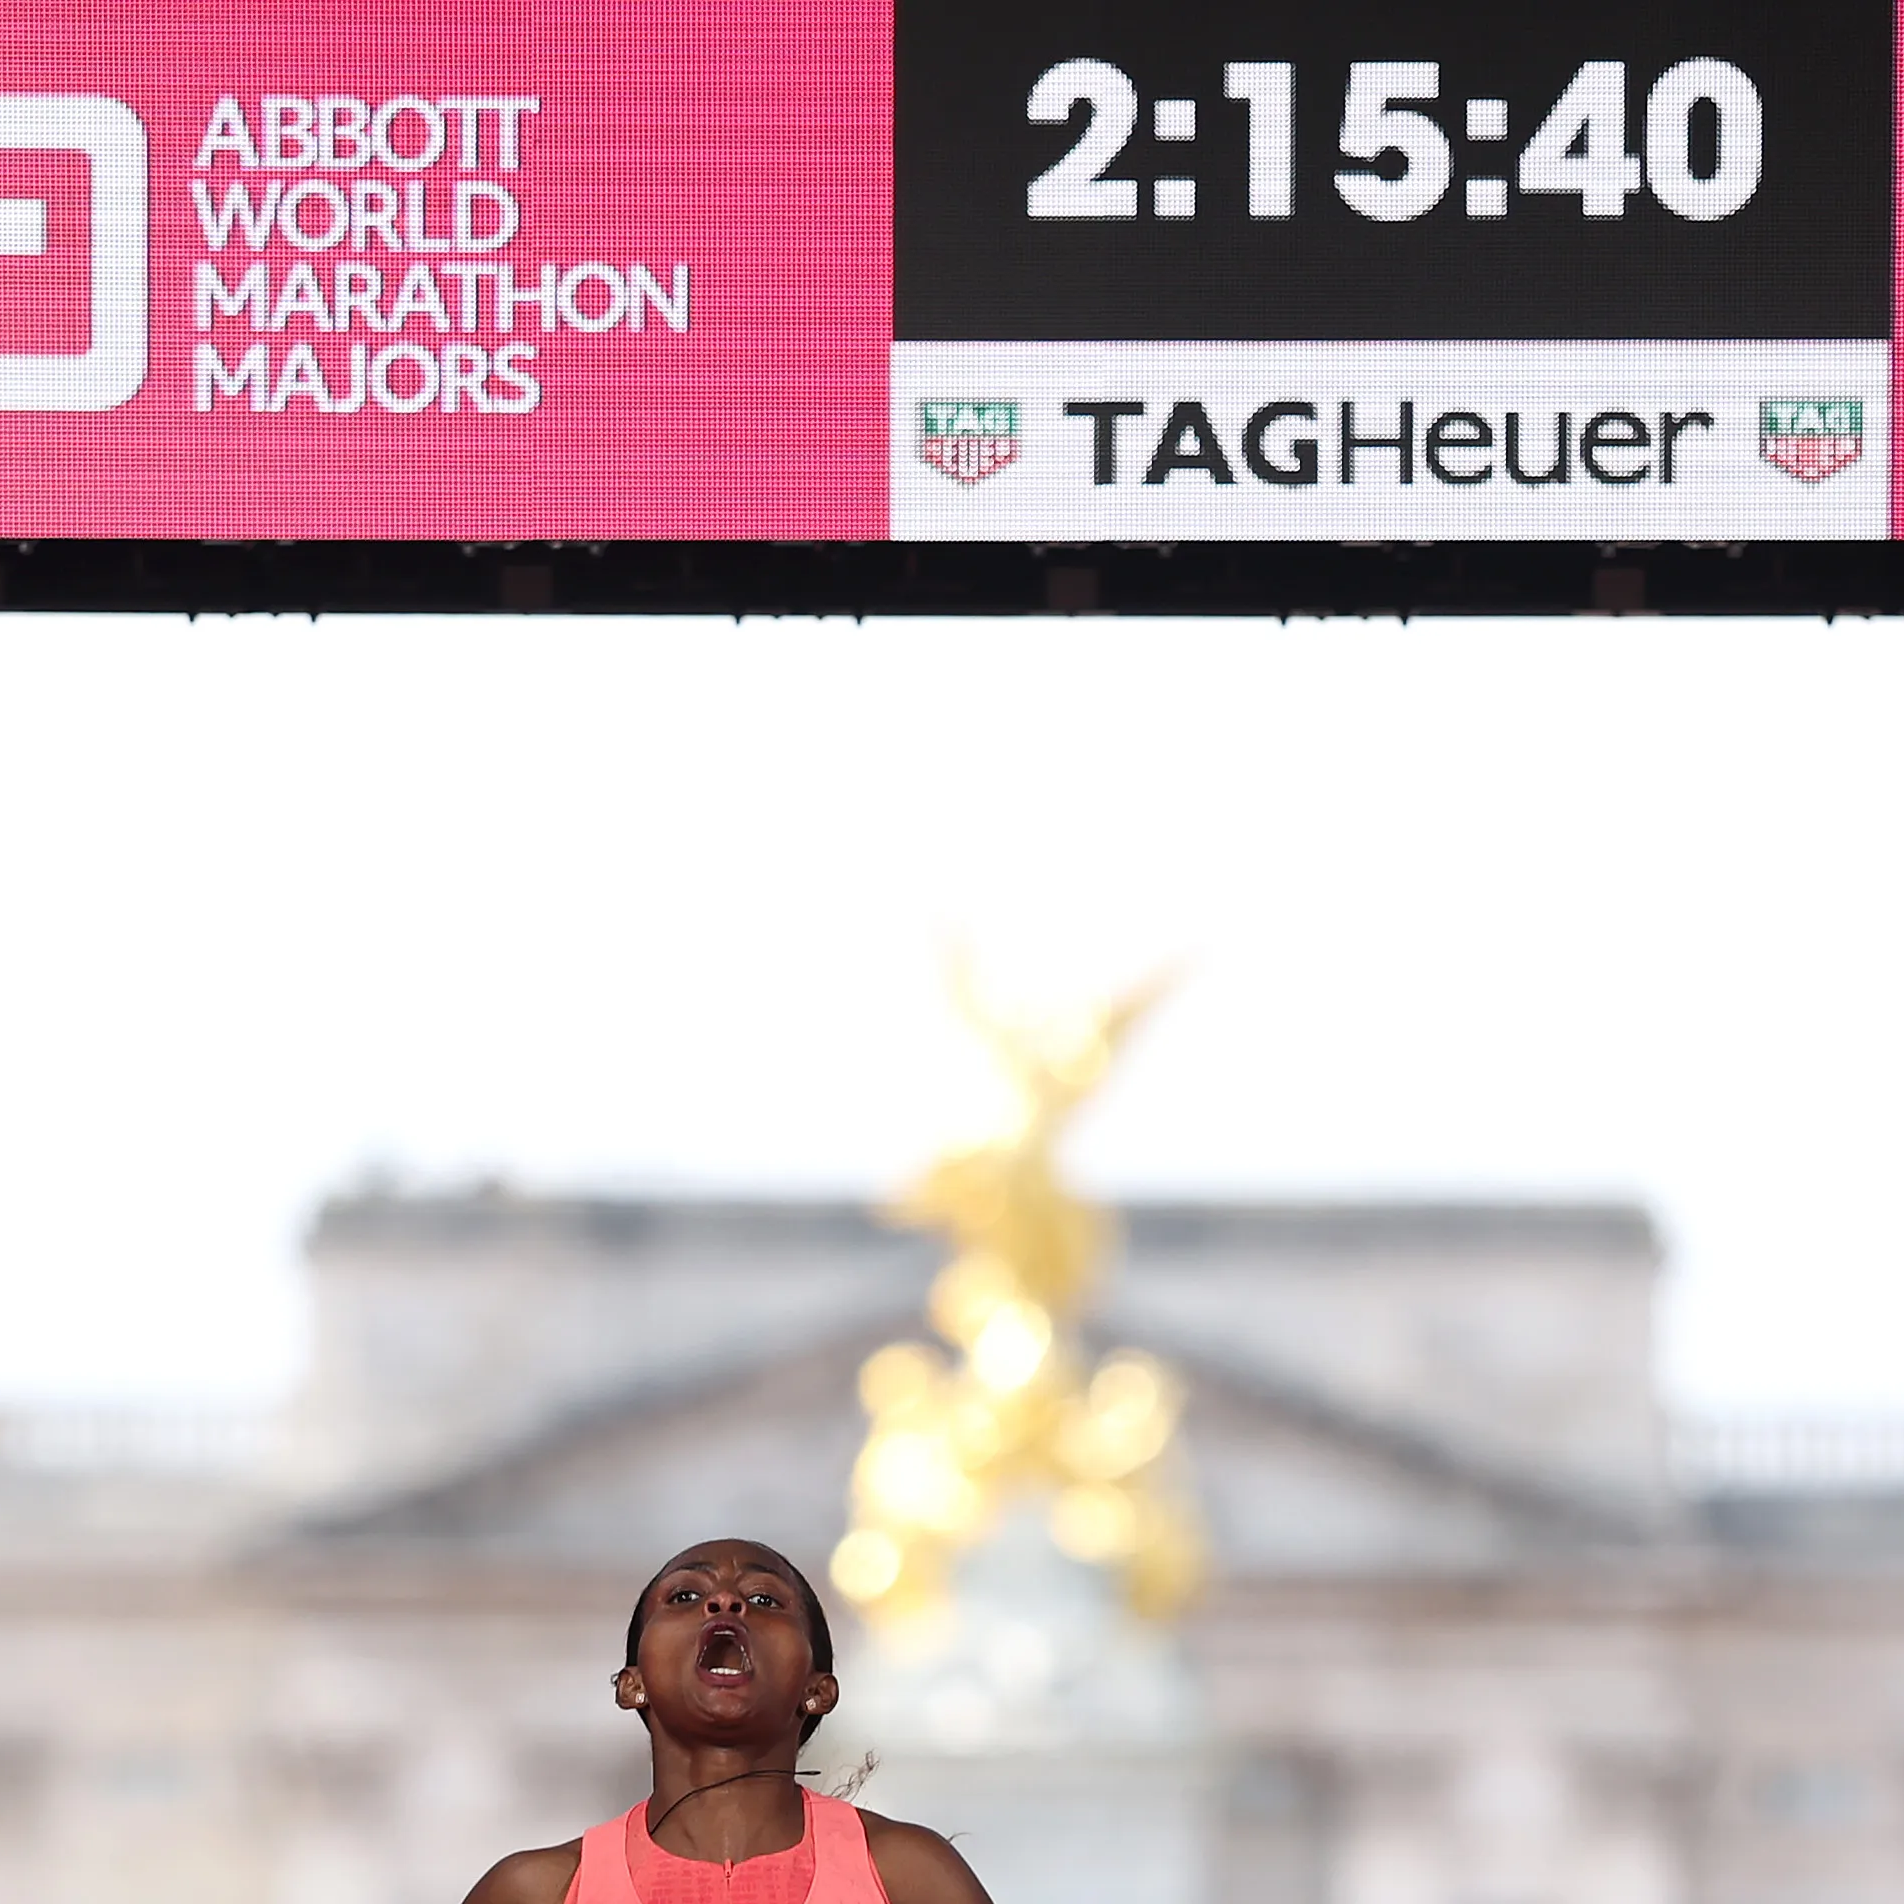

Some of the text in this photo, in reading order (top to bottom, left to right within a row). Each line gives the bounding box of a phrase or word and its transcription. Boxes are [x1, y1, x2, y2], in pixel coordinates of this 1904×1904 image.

[193, 94, 542, 171] ABBOTT
[1026, 56, 1764, 223] 2:15:40
[193, 179, 521, 252] WORLD
[193, 261, 690, 334] MARATHON
[193, 342, 543, 415] MAJORS
